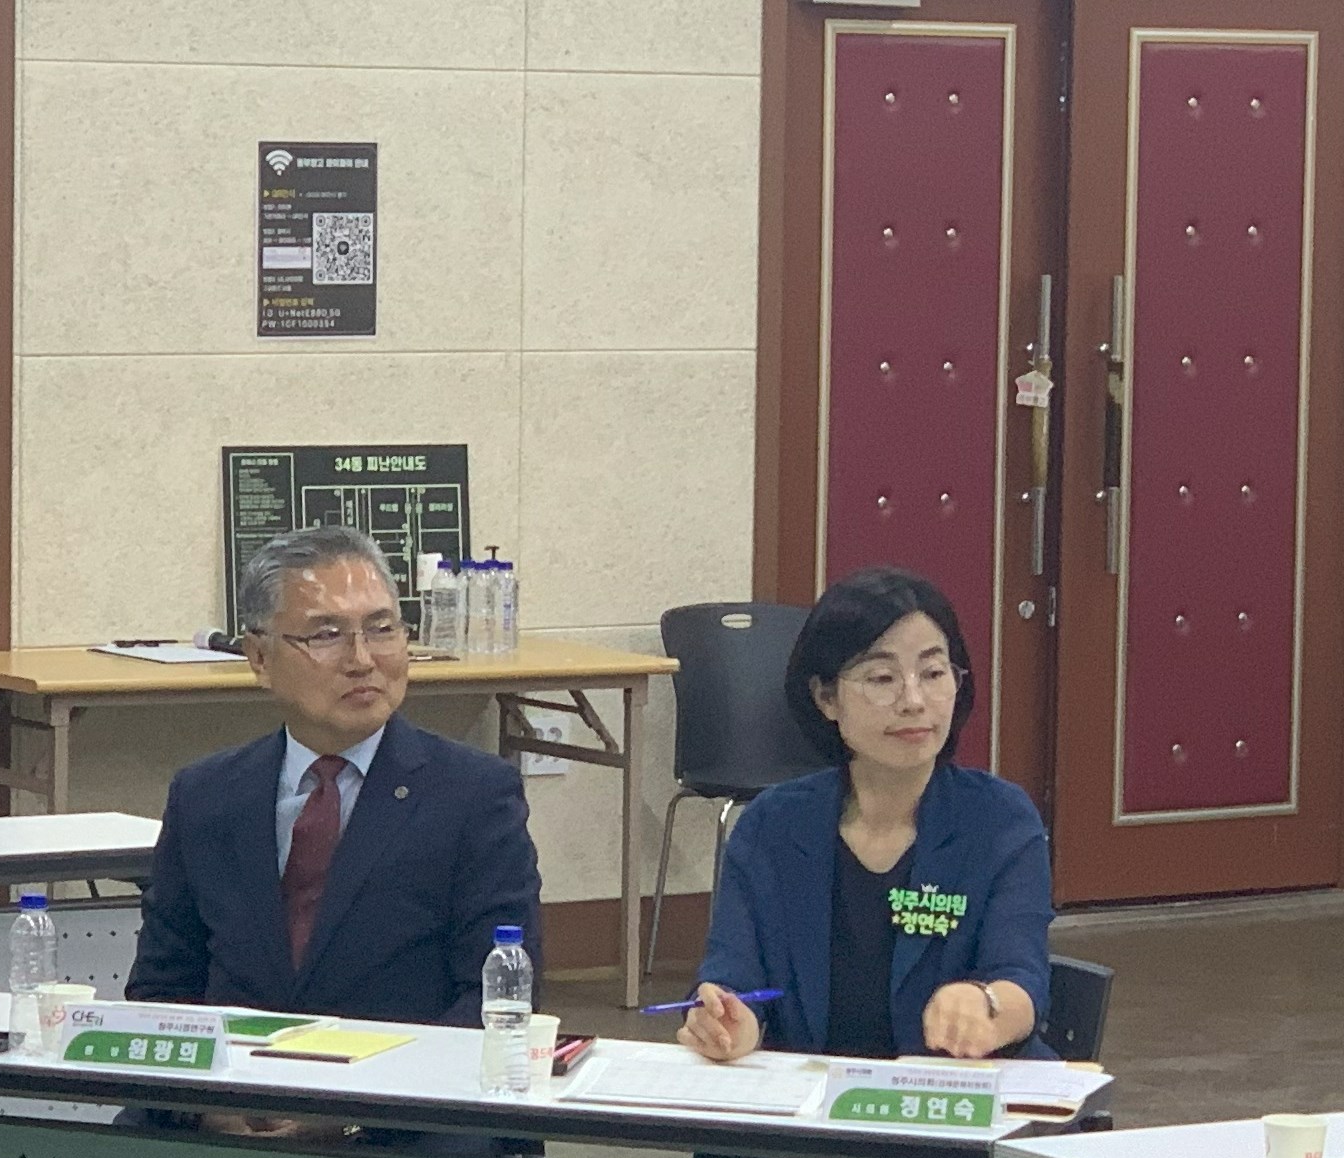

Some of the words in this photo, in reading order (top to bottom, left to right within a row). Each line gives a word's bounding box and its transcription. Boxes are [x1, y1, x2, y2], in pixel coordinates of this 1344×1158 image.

[334, 455, 363, 472] 34동
[366, 455, 427, 472] 피난안내도
[887, 887, 968, 916] 청주시의원
[900, 911, 950, 937] 정연숙
